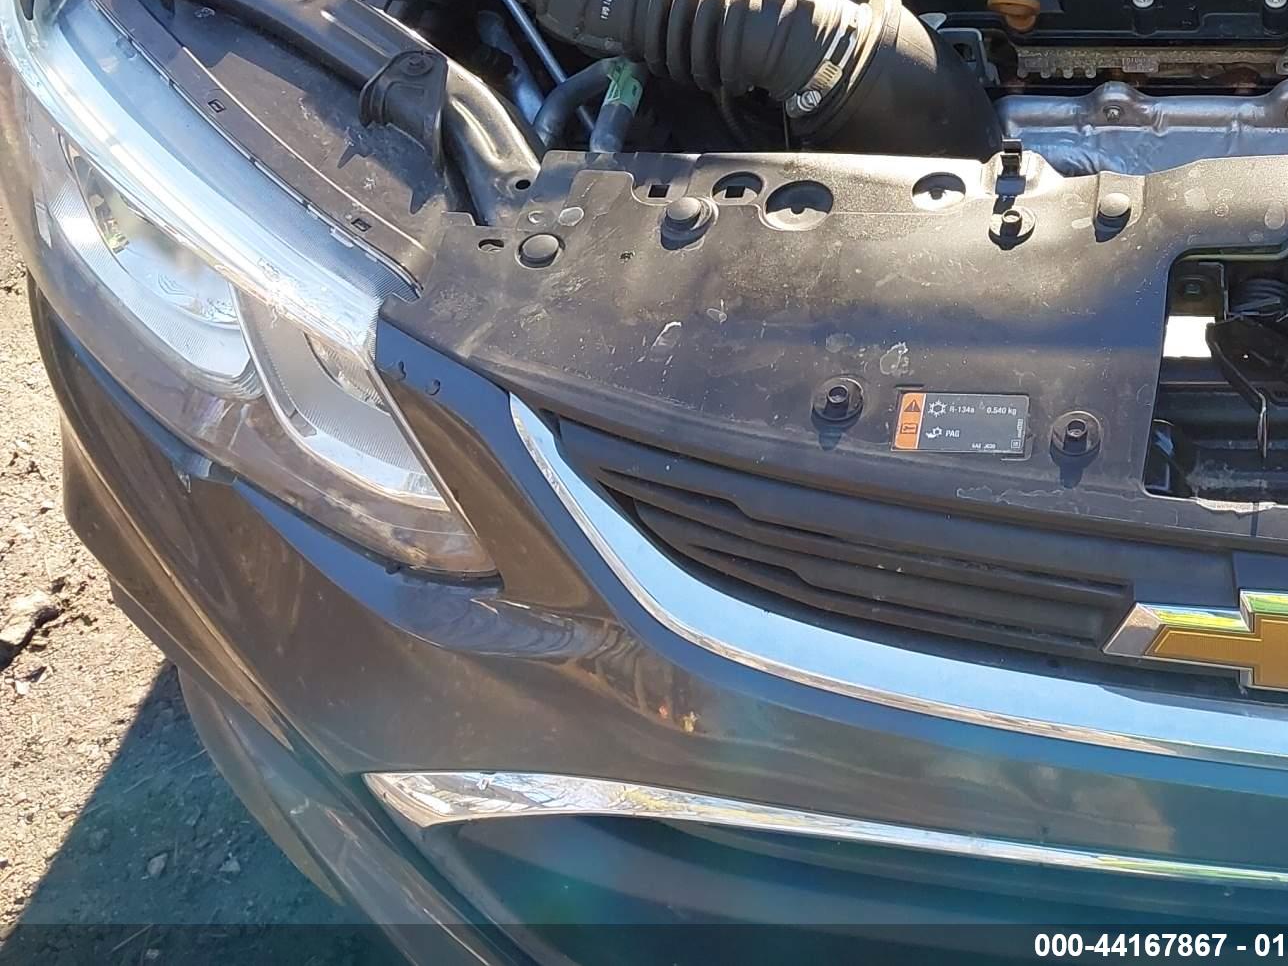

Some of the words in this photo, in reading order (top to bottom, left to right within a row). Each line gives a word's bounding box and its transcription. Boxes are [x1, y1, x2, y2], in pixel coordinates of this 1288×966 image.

[949, 405, 976, 414] R-134a
[986, 406, 1007, 415] 0.540
[945, 429, 961, 438] PAG
